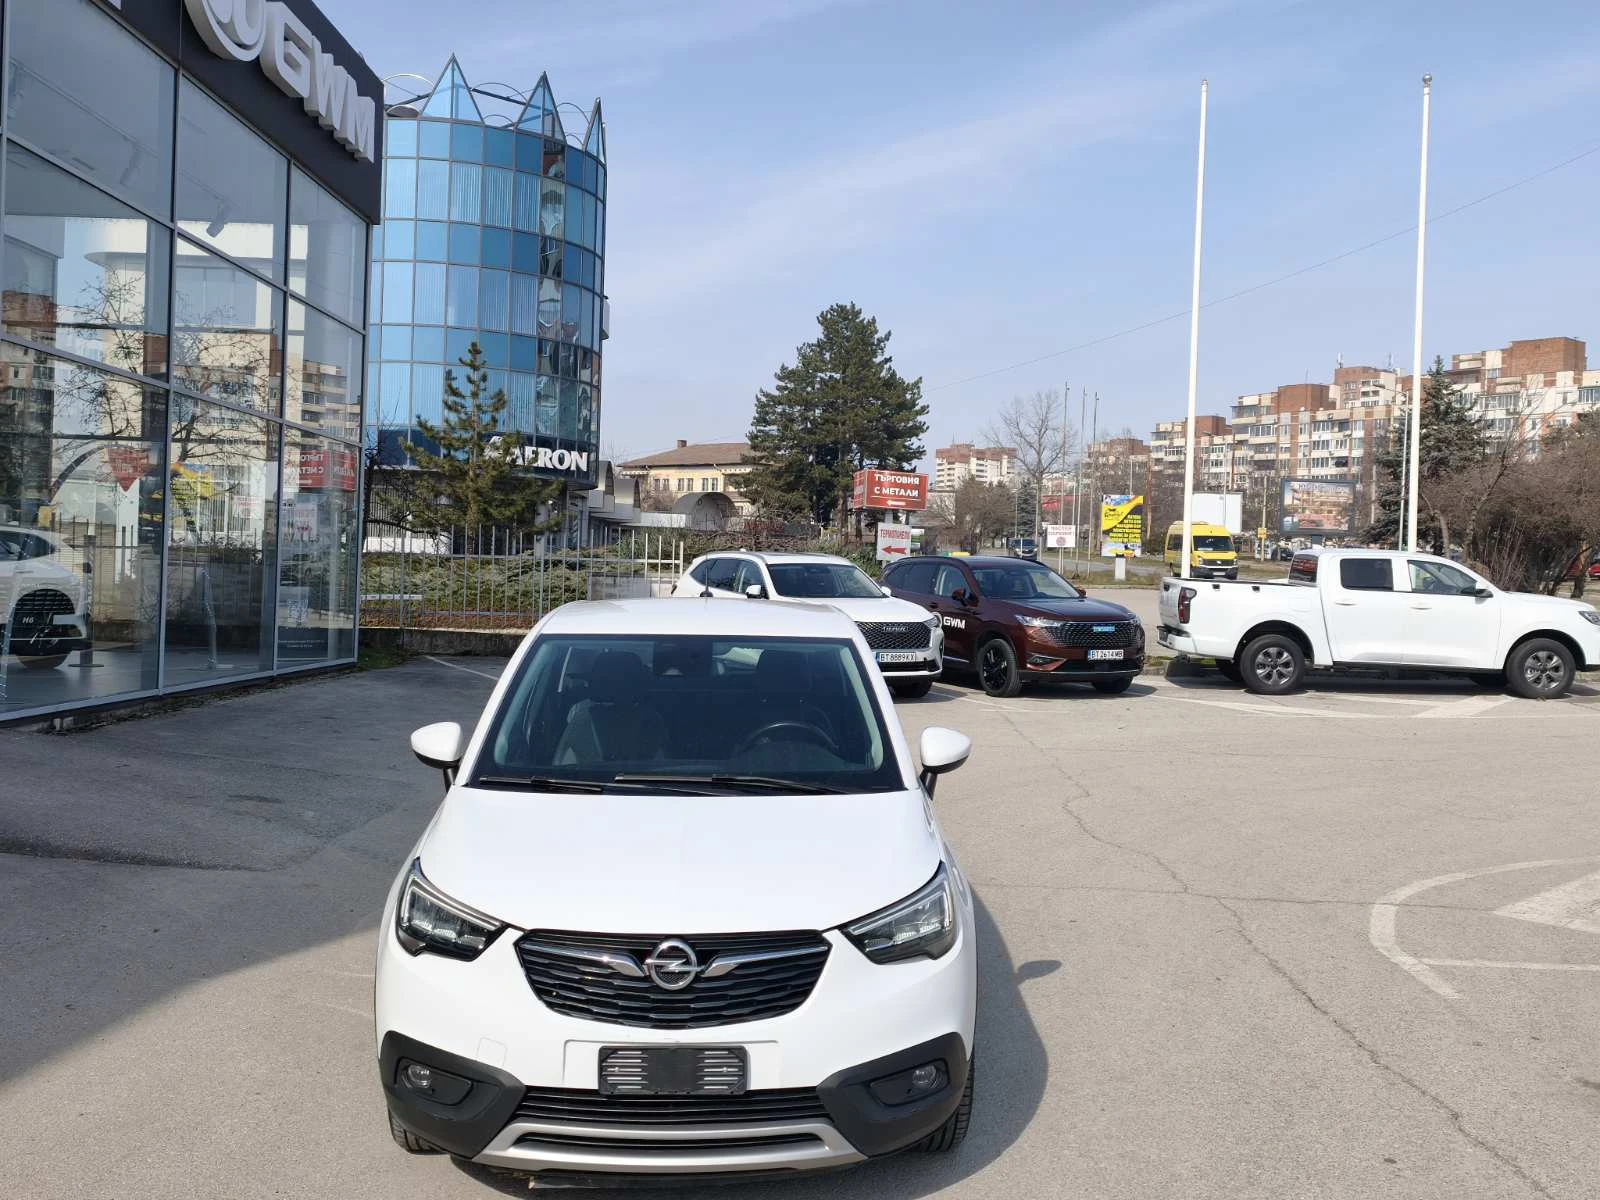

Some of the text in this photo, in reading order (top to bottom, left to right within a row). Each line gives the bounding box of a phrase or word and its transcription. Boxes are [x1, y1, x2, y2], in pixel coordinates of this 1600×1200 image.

[259, 1, 376, 164] GWM
[505, 445, 589, 472] AERON
[874, 473, 920, 485] ТЪРГОВИЯ
[874, 486, 919, 497] С МЕТАЛИ
[943, 616, 966, 629] GWM
